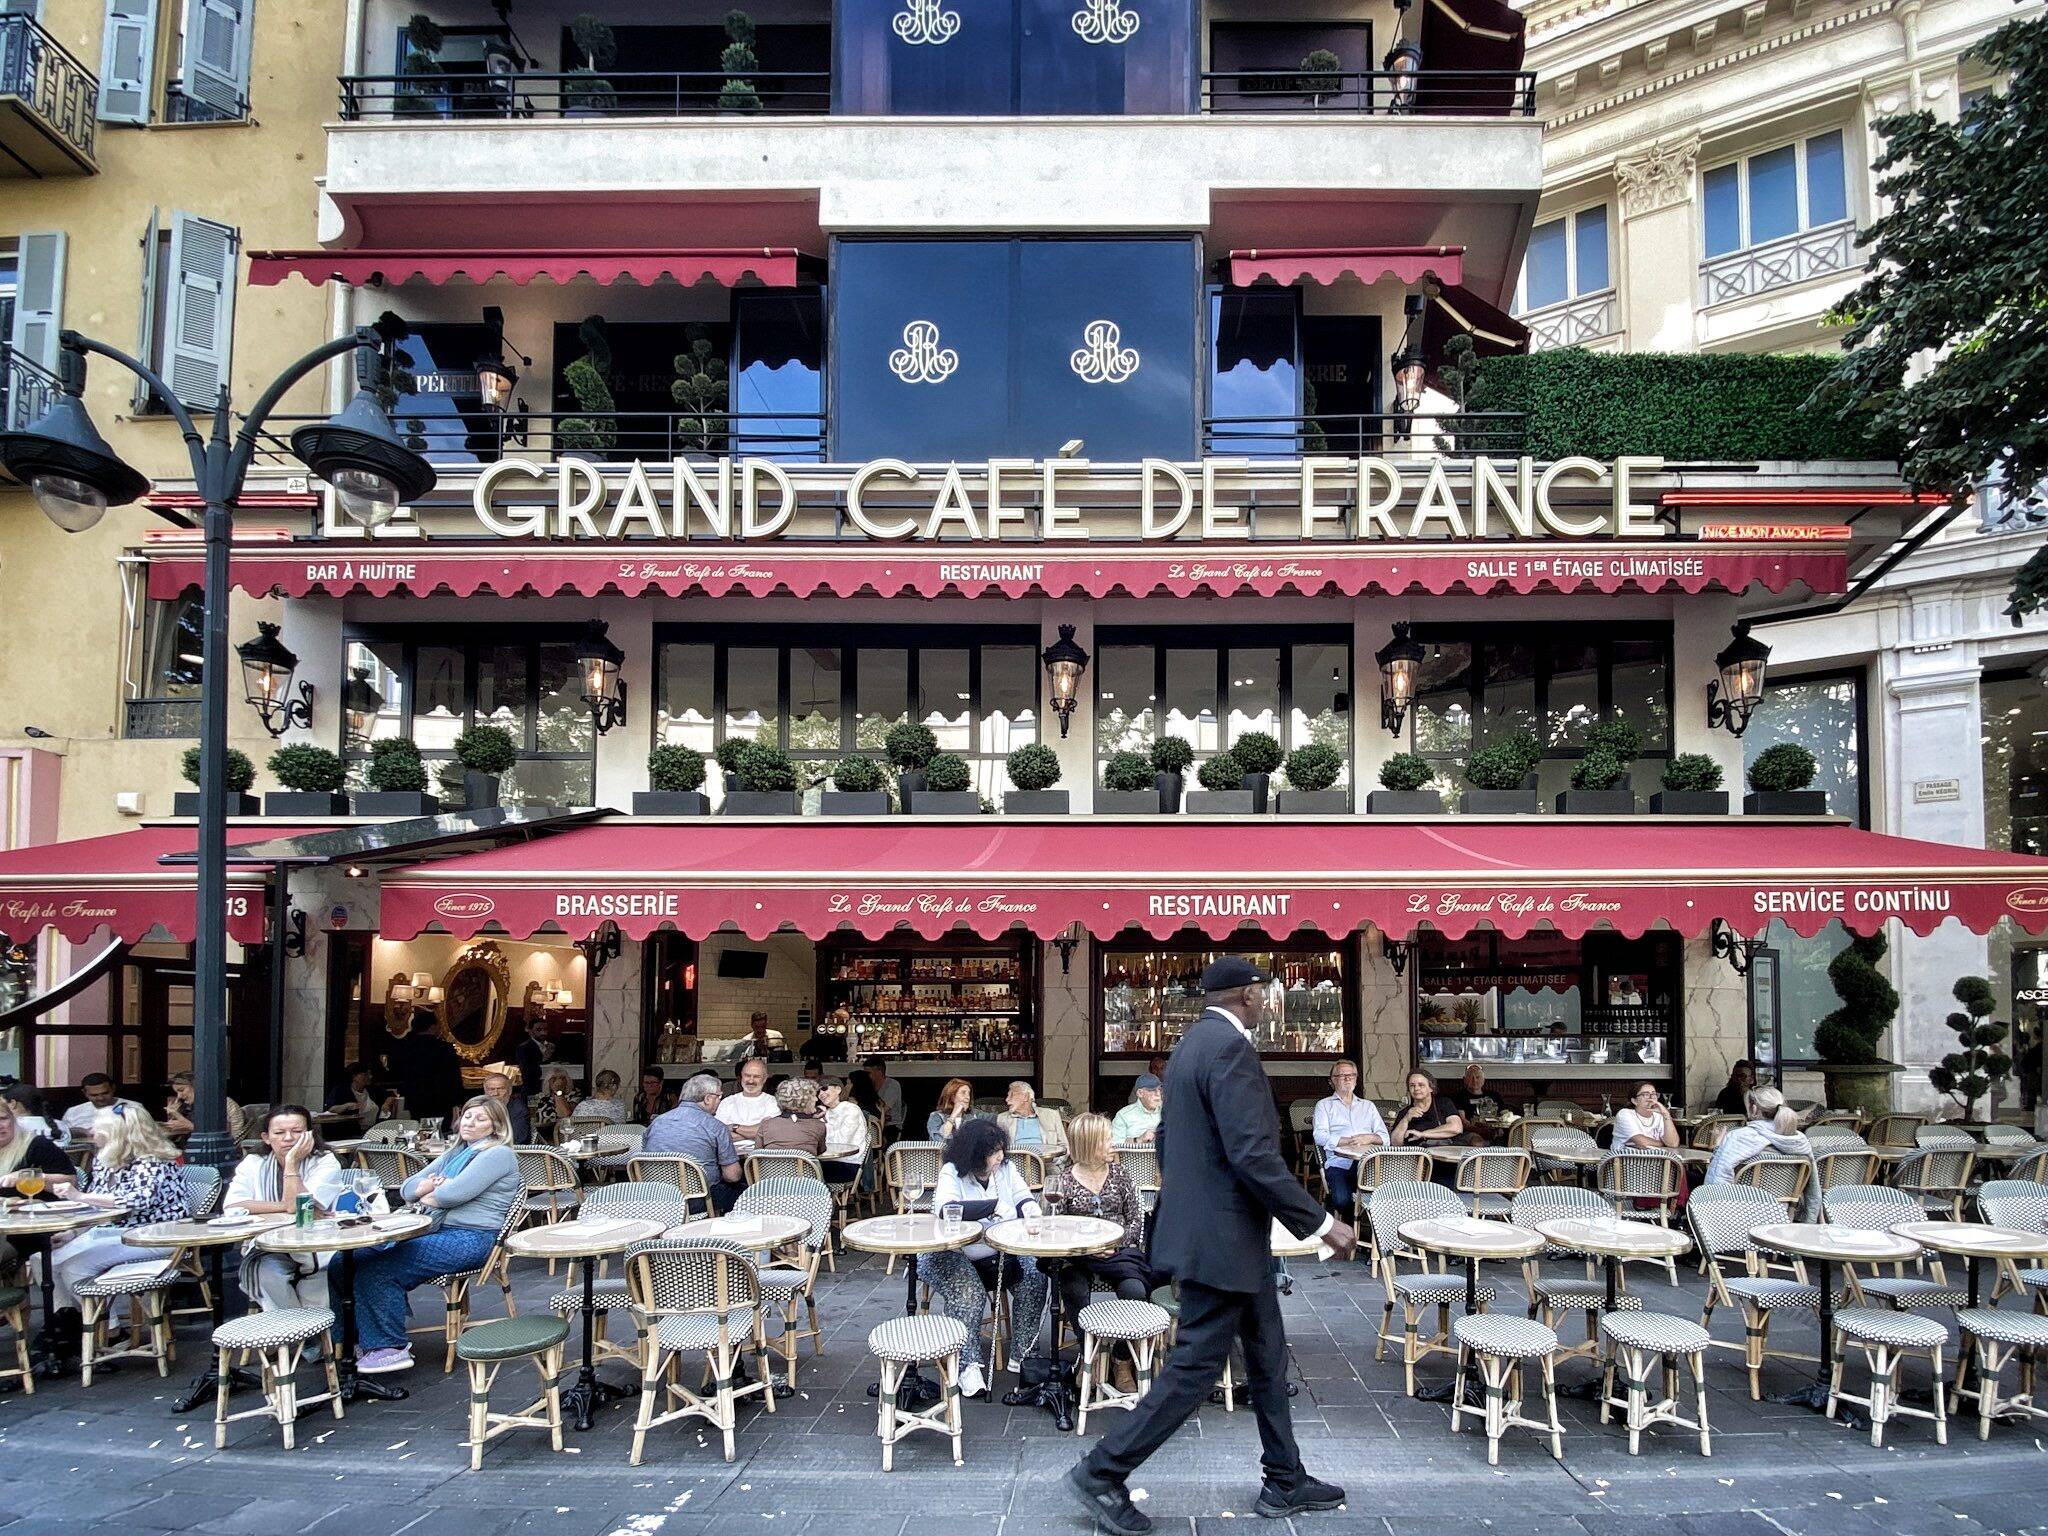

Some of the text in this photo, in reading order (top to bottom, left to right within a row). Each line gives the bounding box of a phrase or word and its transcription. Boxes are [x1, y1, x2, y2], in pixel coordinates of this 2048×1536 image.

[473, 457, 798, 541] GRAND
[846, 438, 1091, 541] CAFÉ
[1141, 458, 1250, 540] DE
[1301, 456, 1666, 540] FRANCE
[1705, 526, 1820, 538] NICE MON AMOUR
[306, 564, 338, 580] BAR
[342, 561, 354, 580] À
[618, 563, 774, 581] Le Grand Café de France
[940, 564, 1044, 581] RESTAURANT
[1167, 563, 1323, 581] Le Grand Café de France
[1467, 561, 1518, 577] SALLE
[1552, 558, 1603, 577] ÉTAGE
[6, 900, 39, 923] Café
[41, 902, 56, 917] de
[61, 900, 117, 917] France
[226, 897, 248, 916] 13
[436, 898, 491, 912] Since 1975
[827, 894, 1038, 918] Le Grand Café de France
[1149, 894, 1291, 916] RESTAURANT
[1405, 893, 1622, 917] Le Grand Café de France
